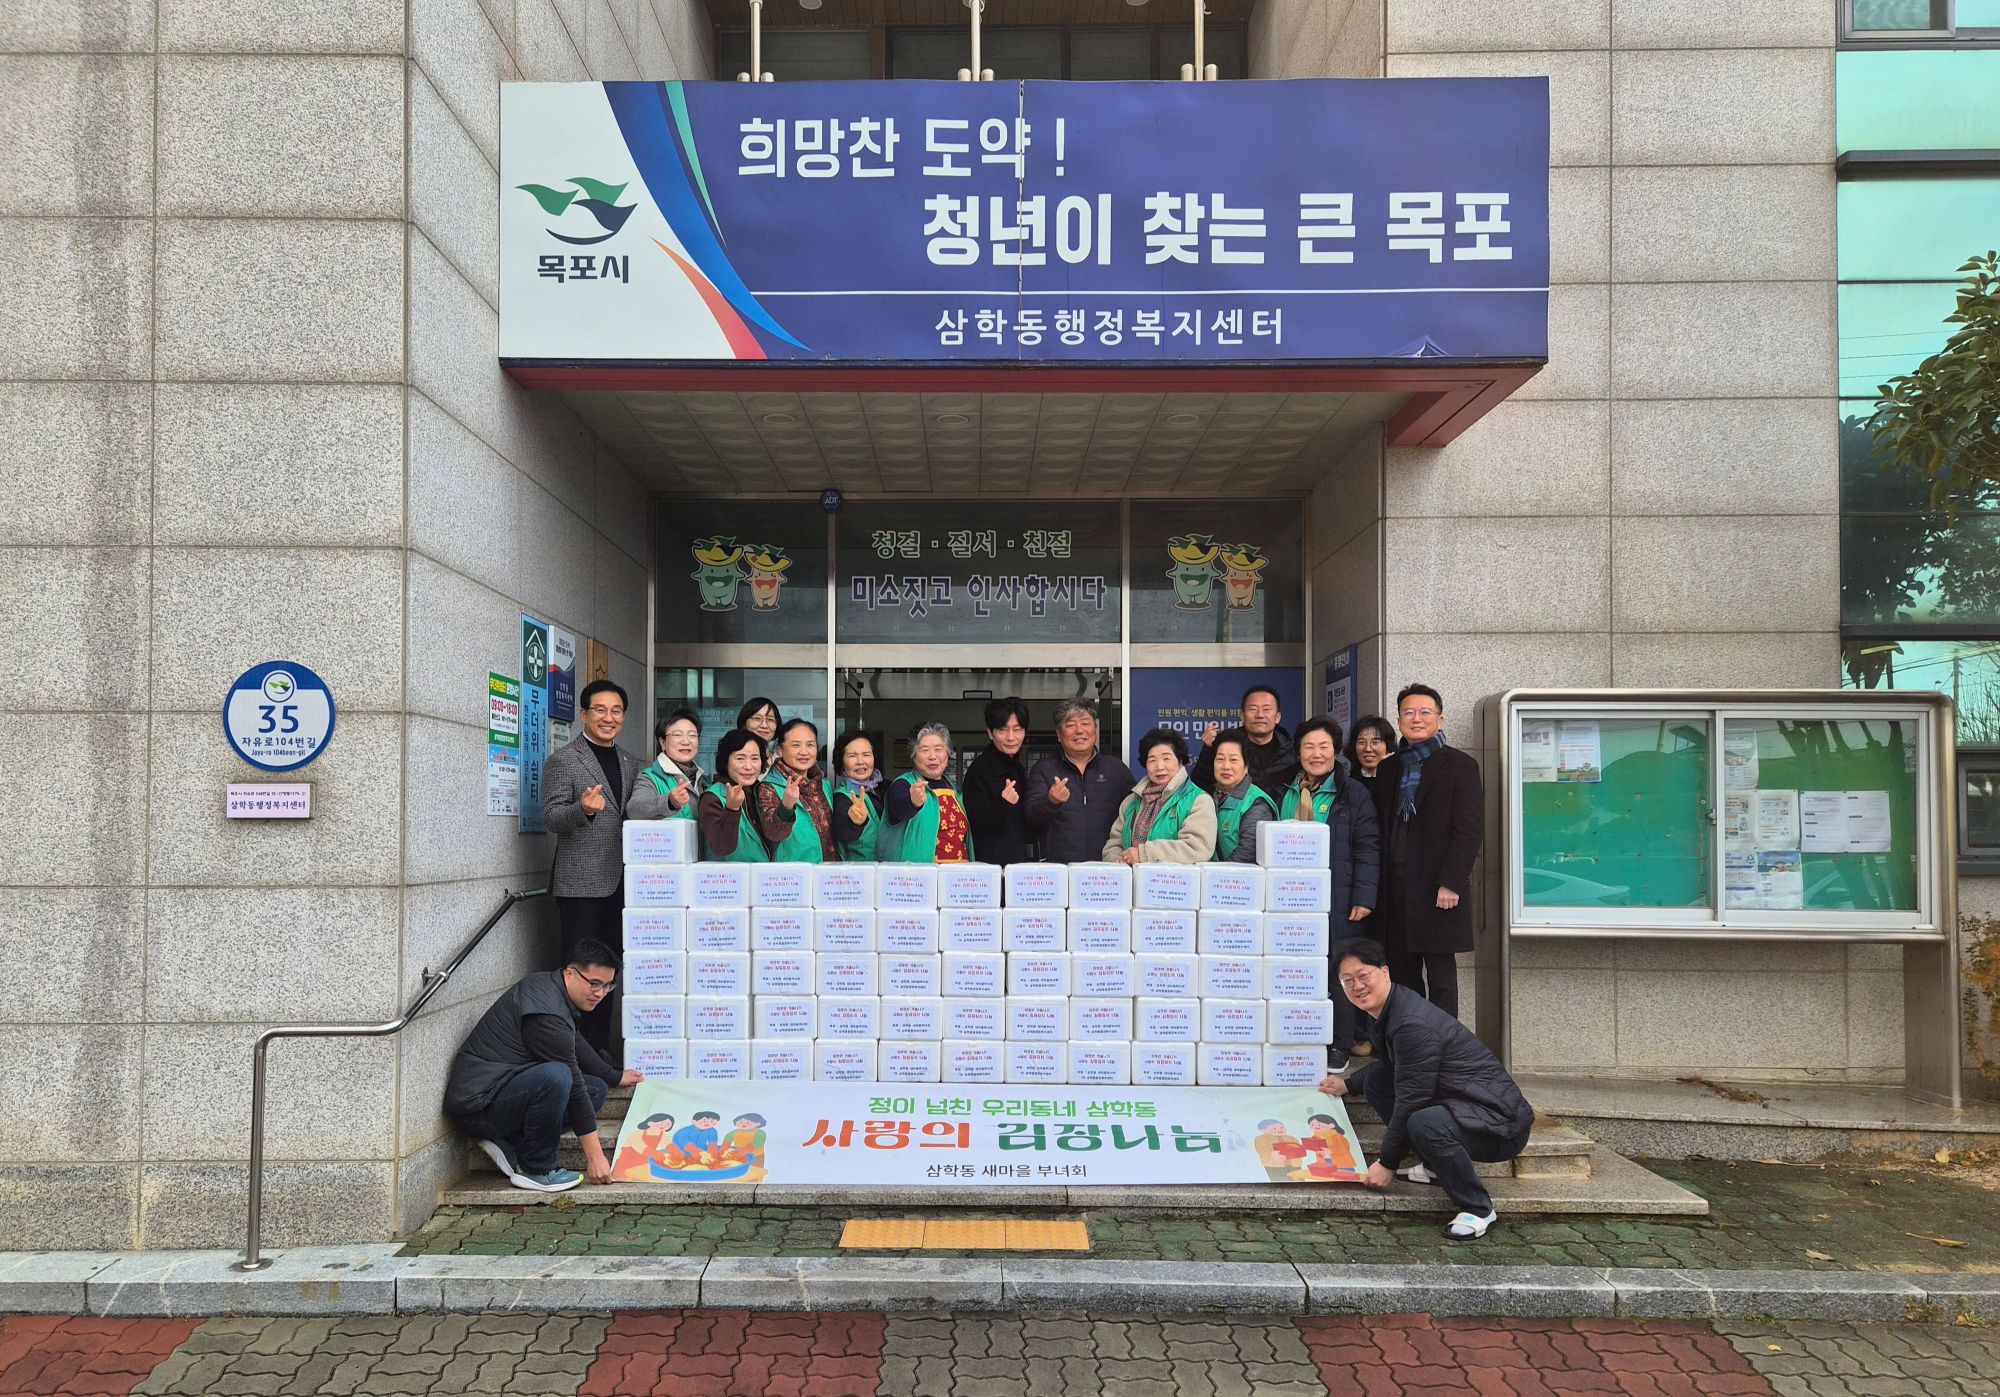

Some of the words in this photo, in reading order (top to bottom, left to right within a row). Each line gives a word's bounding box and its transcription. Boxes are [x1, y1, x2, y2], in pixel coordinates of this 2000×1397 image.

[738, 117, 900, 178] 희망찬
[922, 117, 1031, 179] 도약
[1056, 118, 1065, 177] !
[923, 193, 1112, 266] 청년이
[1143, 191, 1267, 265] 찾는
[1297, 192, 1356, 264] 큰
[1386, 191, 1513, 264] 목포
[537, 254, 630, 284] 목포시
[935, 308, 1283, 347] 삼학동행정복지센터
[824, 496, 838, 505] ADT
[872, 530, 921, 559] 청결
[948, 530, 997, 558] 질서
[1023, 530, 1072, 558] 친절
[851, 574, 953, 618] 미소짓고
[967, 574, 1107, 618] 인사합시다
[258, 705, 299, 734] 35
[531, 689, 539, 753] 무더위
[530, 760, 539, 803] 쉼터
[230, 800, 306, 810] 삼학동행정복지센터
[868, 1097, 916, 1115] 정이
[926, 1098, 972, 1116] 넘친
[982, 1099, 1077, 1118] 우리동네
[1086, 1100, 1157, 1118] 삼학동
[802, 1119, 971, 1150] 사랑의
[926, 1164, 976, 1178] 삼학동
[981, 1164, 1032, 1178] 새마을
[1037, 1164, 1088, 1178] 부녀회
